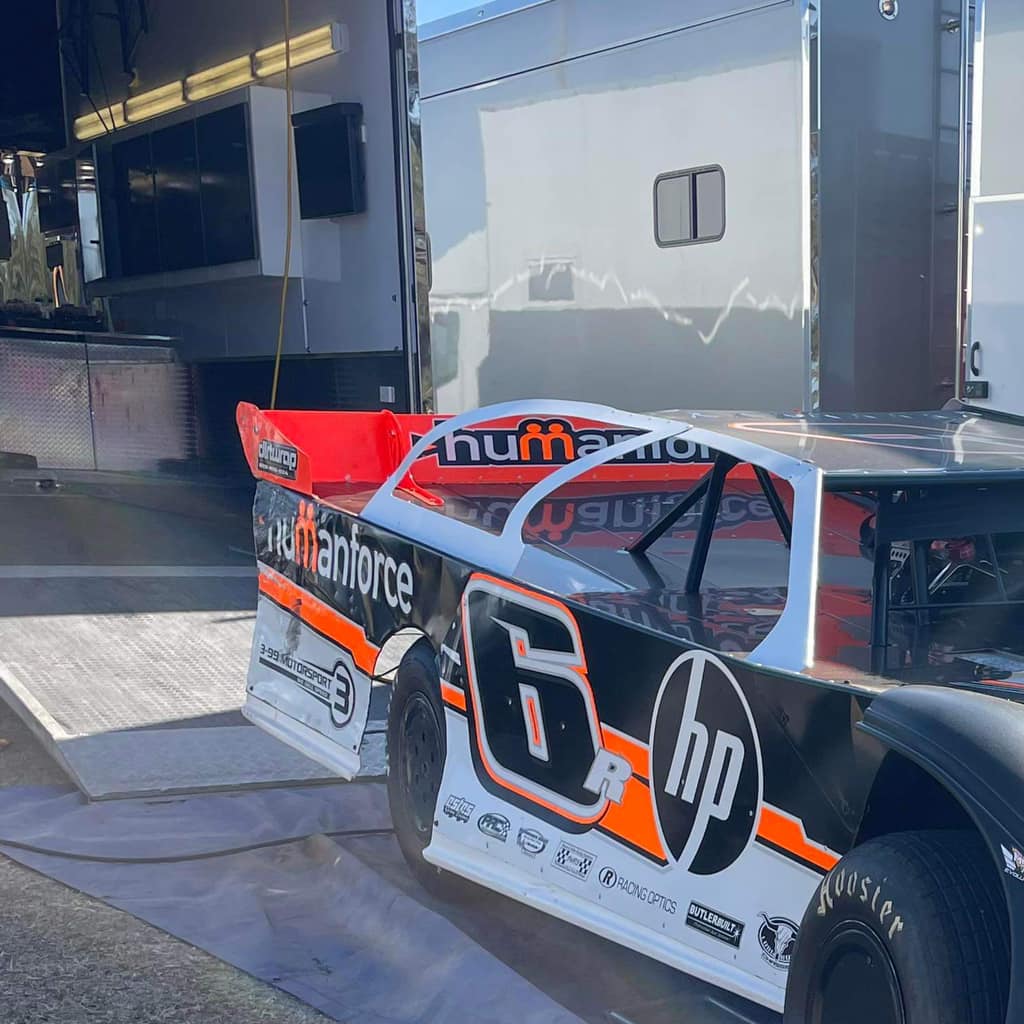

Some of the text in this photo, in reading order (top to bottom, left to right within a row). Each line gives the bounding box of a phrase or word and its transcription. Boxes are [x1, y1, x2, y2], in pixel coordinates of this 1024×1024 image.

[267, 499, 414, 614] humanforce
[280, 653, 332, 689] MOTORSPORT
[333, 672, 350, 715] 3
[462, 572, 611, 826] 6
[583, 749, 633, 804] R
[662, 654, 748, 870] hp
[617, 877, 648, 901] RACING
[648, 890, 677, 914] OPTICS
[690, 904, 736, 934] BUTLERBUILT
[817, 868, 904, 939] Hoosier
